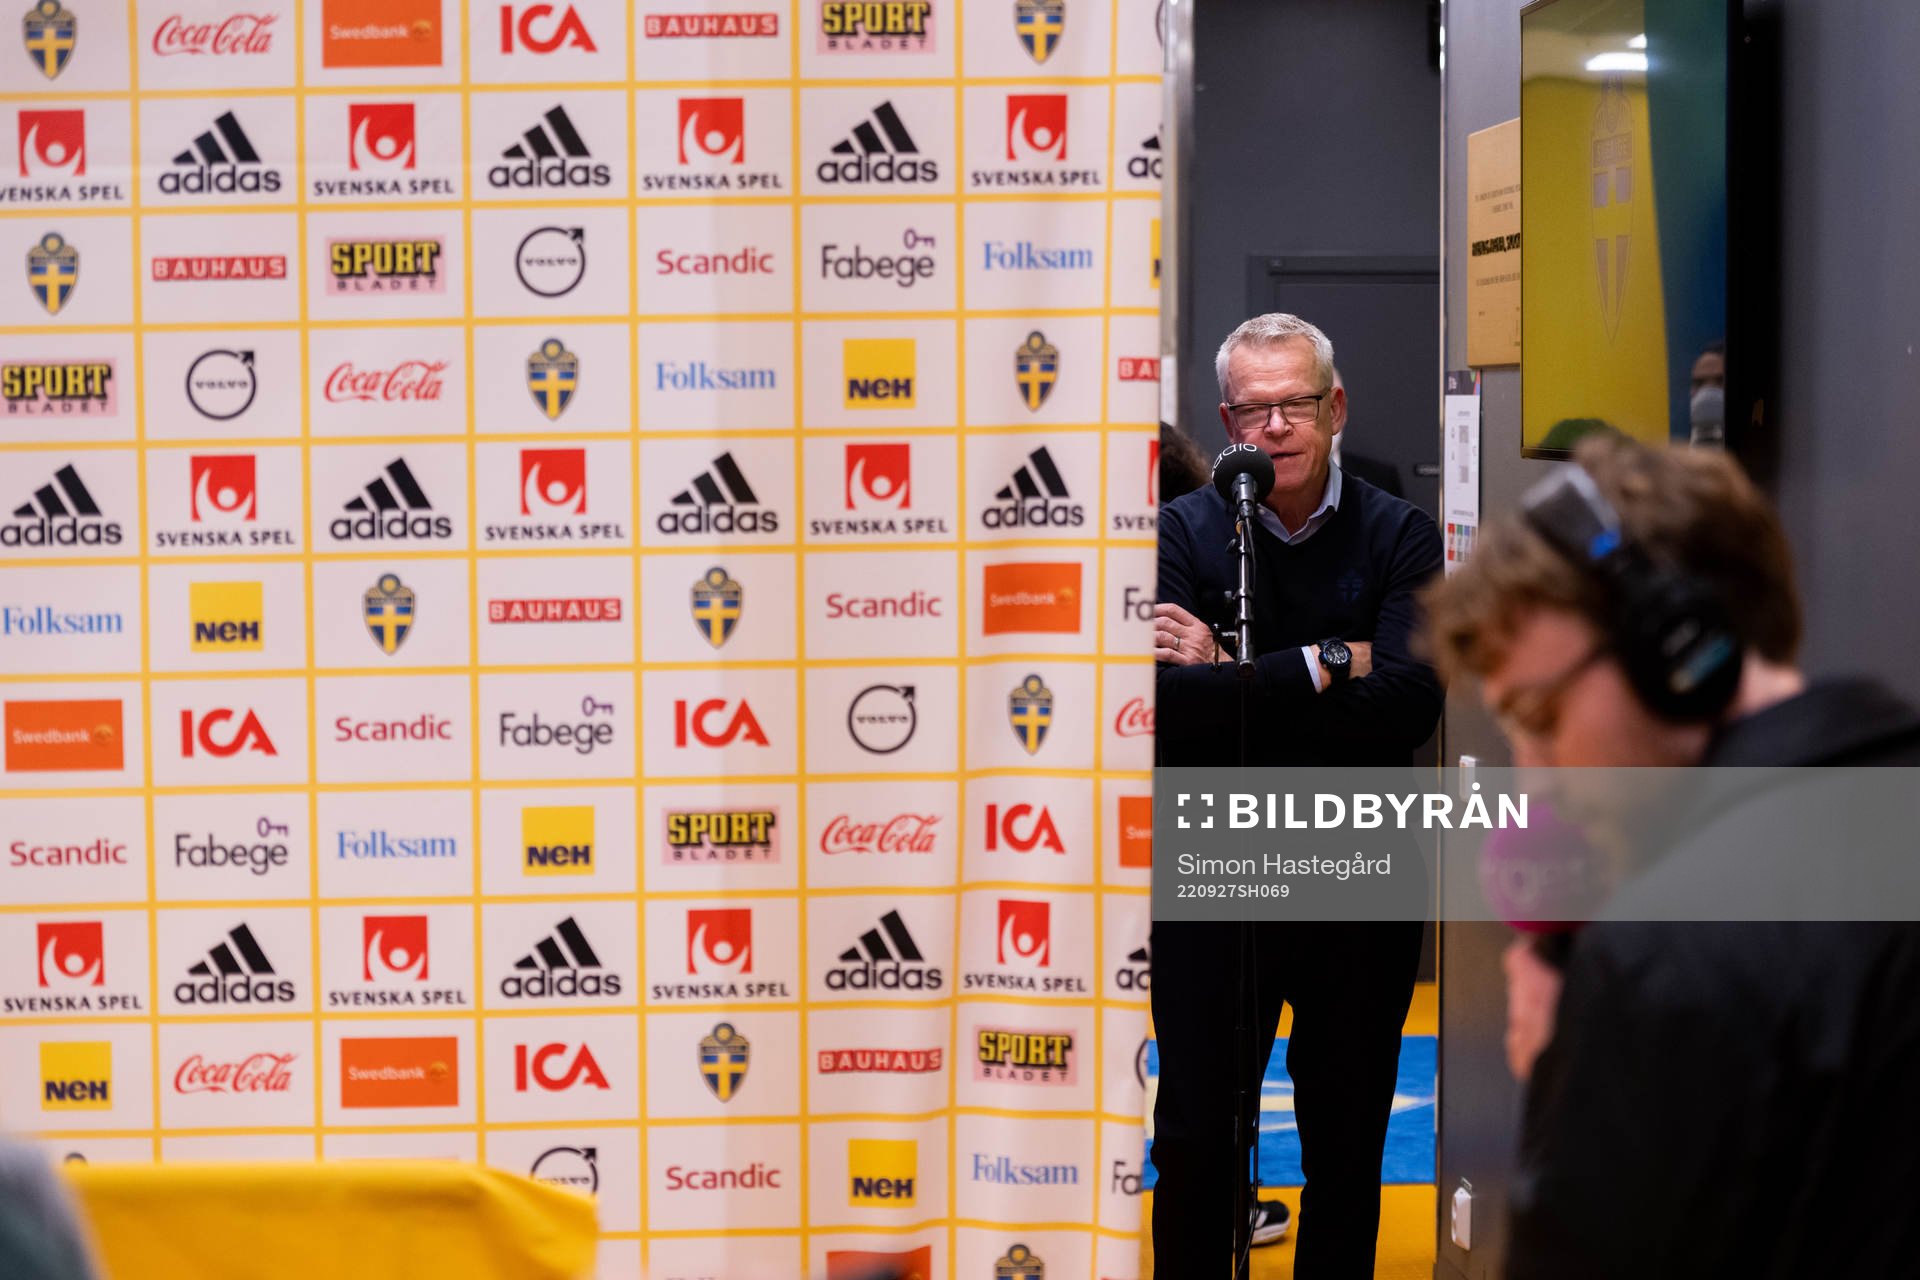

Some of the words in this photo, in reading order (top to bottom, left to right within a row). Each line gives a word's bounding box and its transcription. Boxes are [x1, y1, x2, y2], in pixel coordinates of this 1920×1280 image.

[330, 24, 408, 39] Swedbank
[500, 4, 597, 54] ICA
[646, 15, 777, 37] BAUHAUS
[822, 0, 931, 37] SPORT
[152, 14, 276, 56] Coca-Cola
[828, 39, 926, 50] BLADET
[158, 165, 281, 196] adidas
[488, 159, 611, 190] adidas
[644, 174, 730, 190] SVENSKA
[738, 174, 781, 188] SPEL
[816, 155, 939, 186] adidas
[972, 171, 1054, 186] SVENSKA
[1059, 170, 1099, 186] SPEL
[79, 185, 122, 200] SPEL
[314, 180, 401, 196] SVENSKA
[409, 179, 453, 194] SPEL
[152, 257, 286, 280] BAUHAUS
[331, 240, 441, 278] SPORT
[524, 257, 579, 267] VOLVO
[657, 248, 774, 274] Scandic
[821, 243, 935, 288] Fabege
[984, 241, 1092, 270] Folksam
[337, 279, 438, 291] BLADET
[2, 362, 112, 400] SPORT
[195, 380, 249, 389] VOLVO
[324, 361, 447, 402] Coca-Cola
[657, 362, 776, 390] Folksam
[7, 401, 108, 414] BLADET
[1211, 443, 1257, 480] adio
[329, 509, 453, 541] adidas
[656, 503, 779, 536] adidas
[811, 520, 896, 535] SVENSKA
[904, 519, 947, 533] SPEL
[981, 497, 1085, 530] adidas
[0, 516, 123, 548] adidas
[156, 531, 242, 546] SVENSKA
[250, 530, 294, 545] SPEL
[486, 525, 572, 540] SVENSKA
[580, 524, 624, 539] SPEL
[490, 600, 622, 622] BAUHAUS
[826, 592, 941, 618] Scandic
[991, 592, 1059, 606] Swedbank
[3, 607, 122, 635] Folksam
[335, 714, 451, 741] Scandic
[675, 698, 770, 748] ICA
[856, 713, 910, 724] VOLVO
[13, 729, 90, 744] Swedbank
[181, 708, 277, 758] ICA
[500, 712, 614, 755] Fabege
[668, 811, 776, 847] SPORT
[820, 814, 939, 855] Coca-Cola
[985, 803, 1065, 854] ICA
[10, 839, 126, 866] Scandic
[175, 834, 290, 877] Fabege
[338, 831, 456, 858] Folksam
[673, 848, 773, 861] BLADET
[173, 974, 297, 1005] adidas
[500, 970, 623, 1000] adidas
[824, 959, 944, 993] adidas
[963, 973, 1036, 992] SVENSKA
[1043, 978, 1086, 992] SPEL
[4, 997, 90, 1011] SVENSKA
[98, 996, 141, 1009] SPEL
[330, 991, 414, 1005] SVENSKA
[422, 990, 466, 1004] SPEL
[653, 984, 738, 999] SVENSKA
[745, 983, 789, 997] SPEL
[819, 1050, 943, 1073] BAUHAUS
[977, 1030, 1073, 1071] SPORT
[174, 1053, 294, 1094] Coca-Cola
[349, 1066, 424, 1080] Swedbank
[515, 1043, 610, 1092] ICA
[983, 1067, 1069, 1082] BLADET
[666, 1163, 781, 1190] Scandic
[974, 1154, 1078, 1184] Folksam
